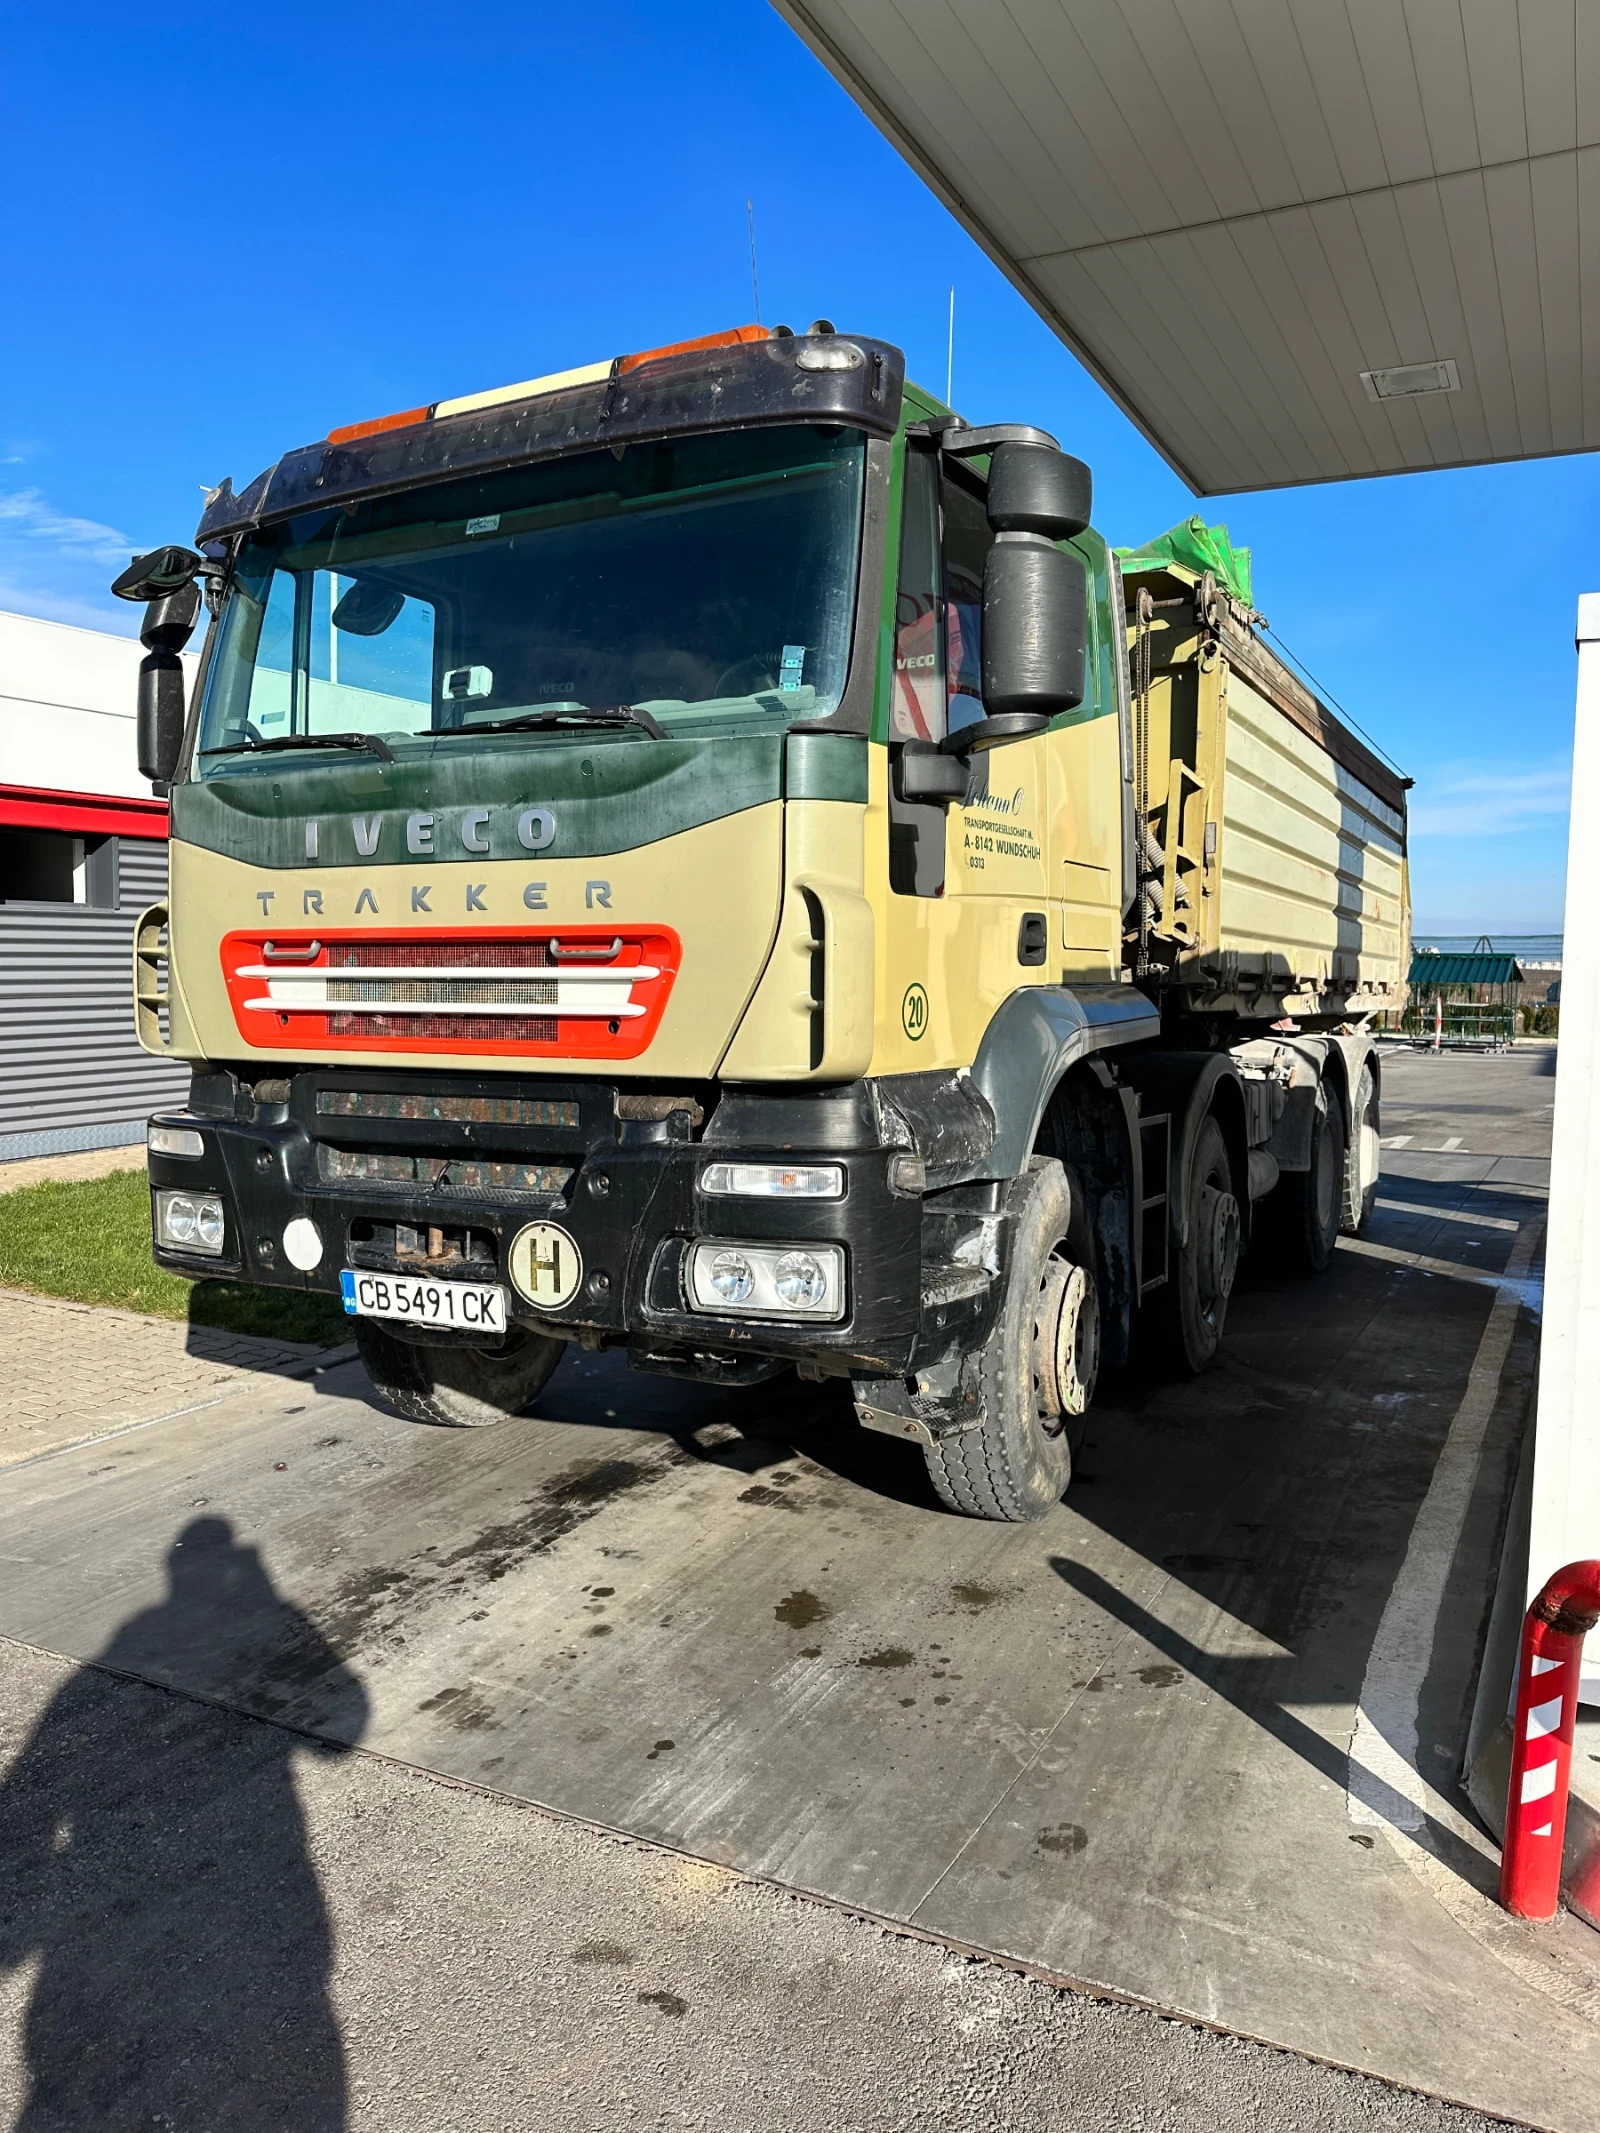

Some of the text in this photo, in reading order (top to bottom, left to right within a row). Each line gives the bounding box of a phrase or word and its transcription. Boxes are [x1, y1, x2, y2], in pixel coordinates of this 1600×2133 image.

[897, 654, 935, 669] VECO
[540, 682, 575, 695] IVECO
[305, 808, 556, 859] IVECO
[996, 838, 1041, 861] WUNDSCHUH
[257, 881, 612, 916] TRAKKER
[908, 995, 923, 1028] 20
[530, 1238, 561, 1294] H
